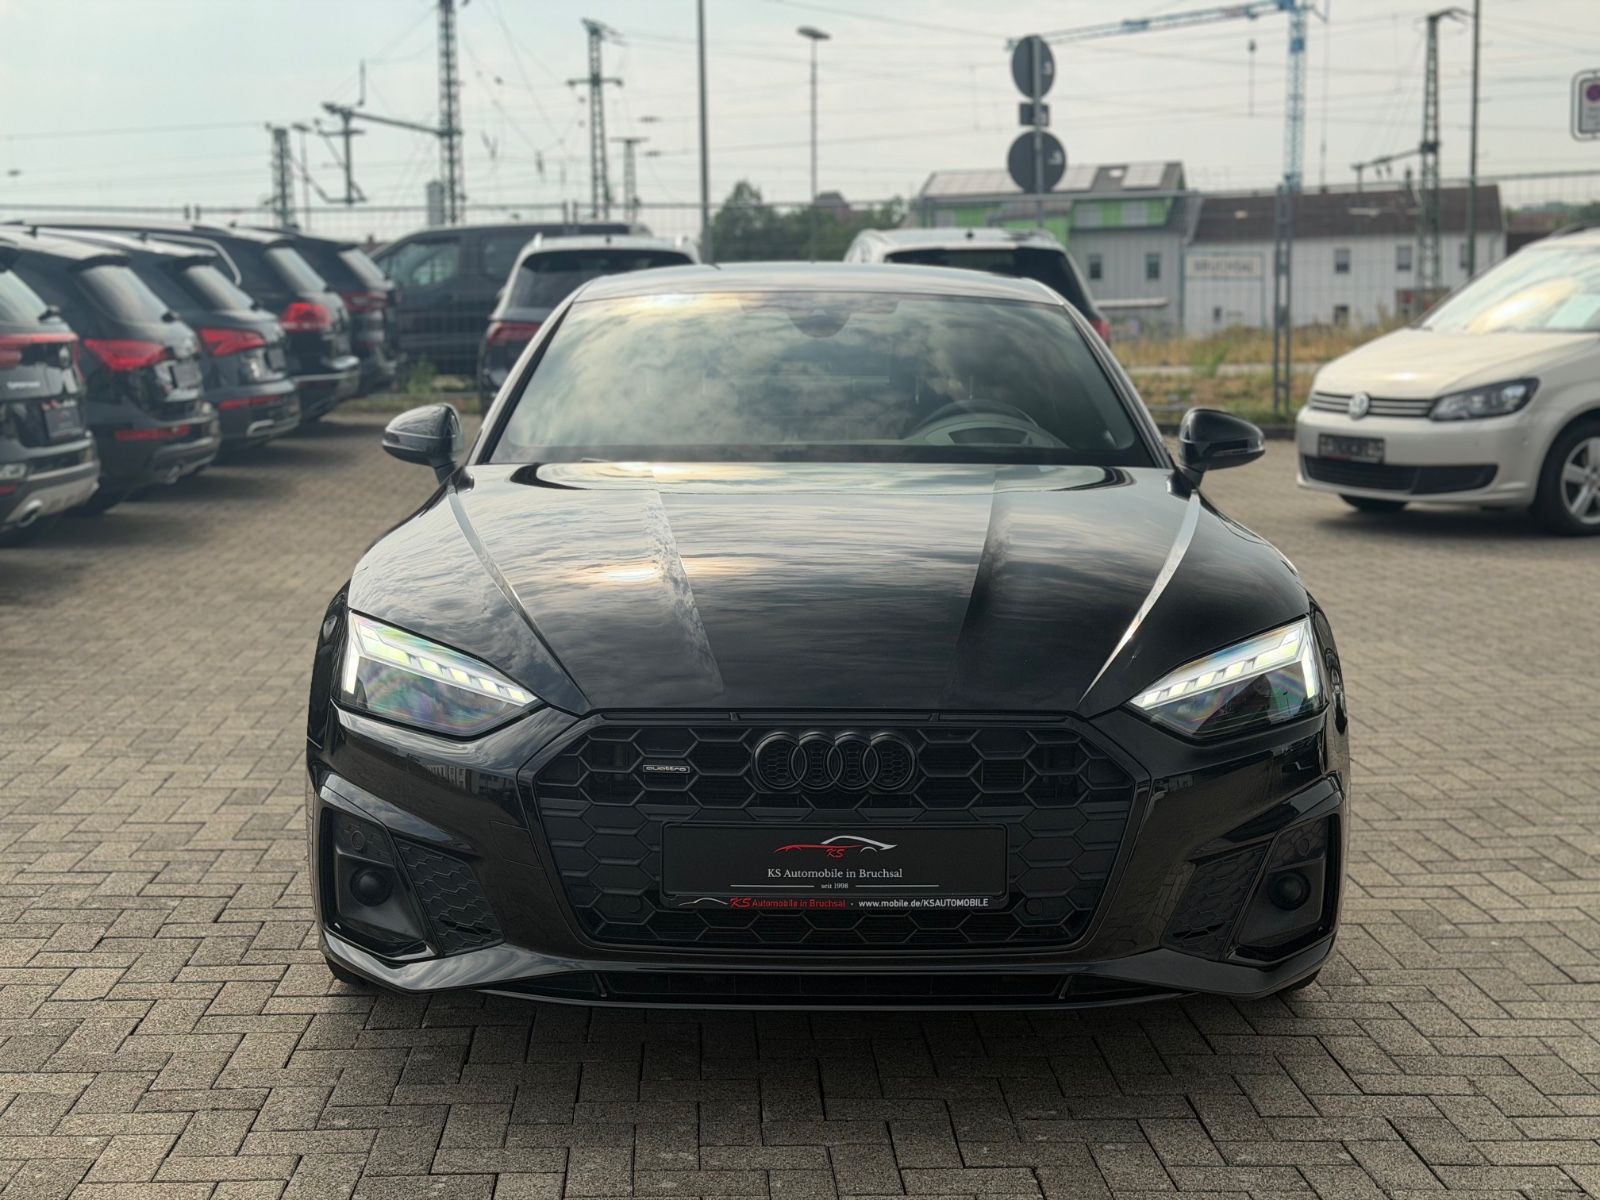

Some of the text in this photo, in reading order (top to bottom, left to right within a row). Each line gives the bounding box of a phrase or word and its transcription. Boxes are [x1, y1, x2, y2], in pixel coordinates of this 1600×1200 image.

[826, 848, 846, 858] KS
[767, 868, 903, 878] KS Automobile in Bruchsal
[730, 897, 989, 908] KS Automobile in Bruchsal www.mobile.de/KSAUTOMOBILE
